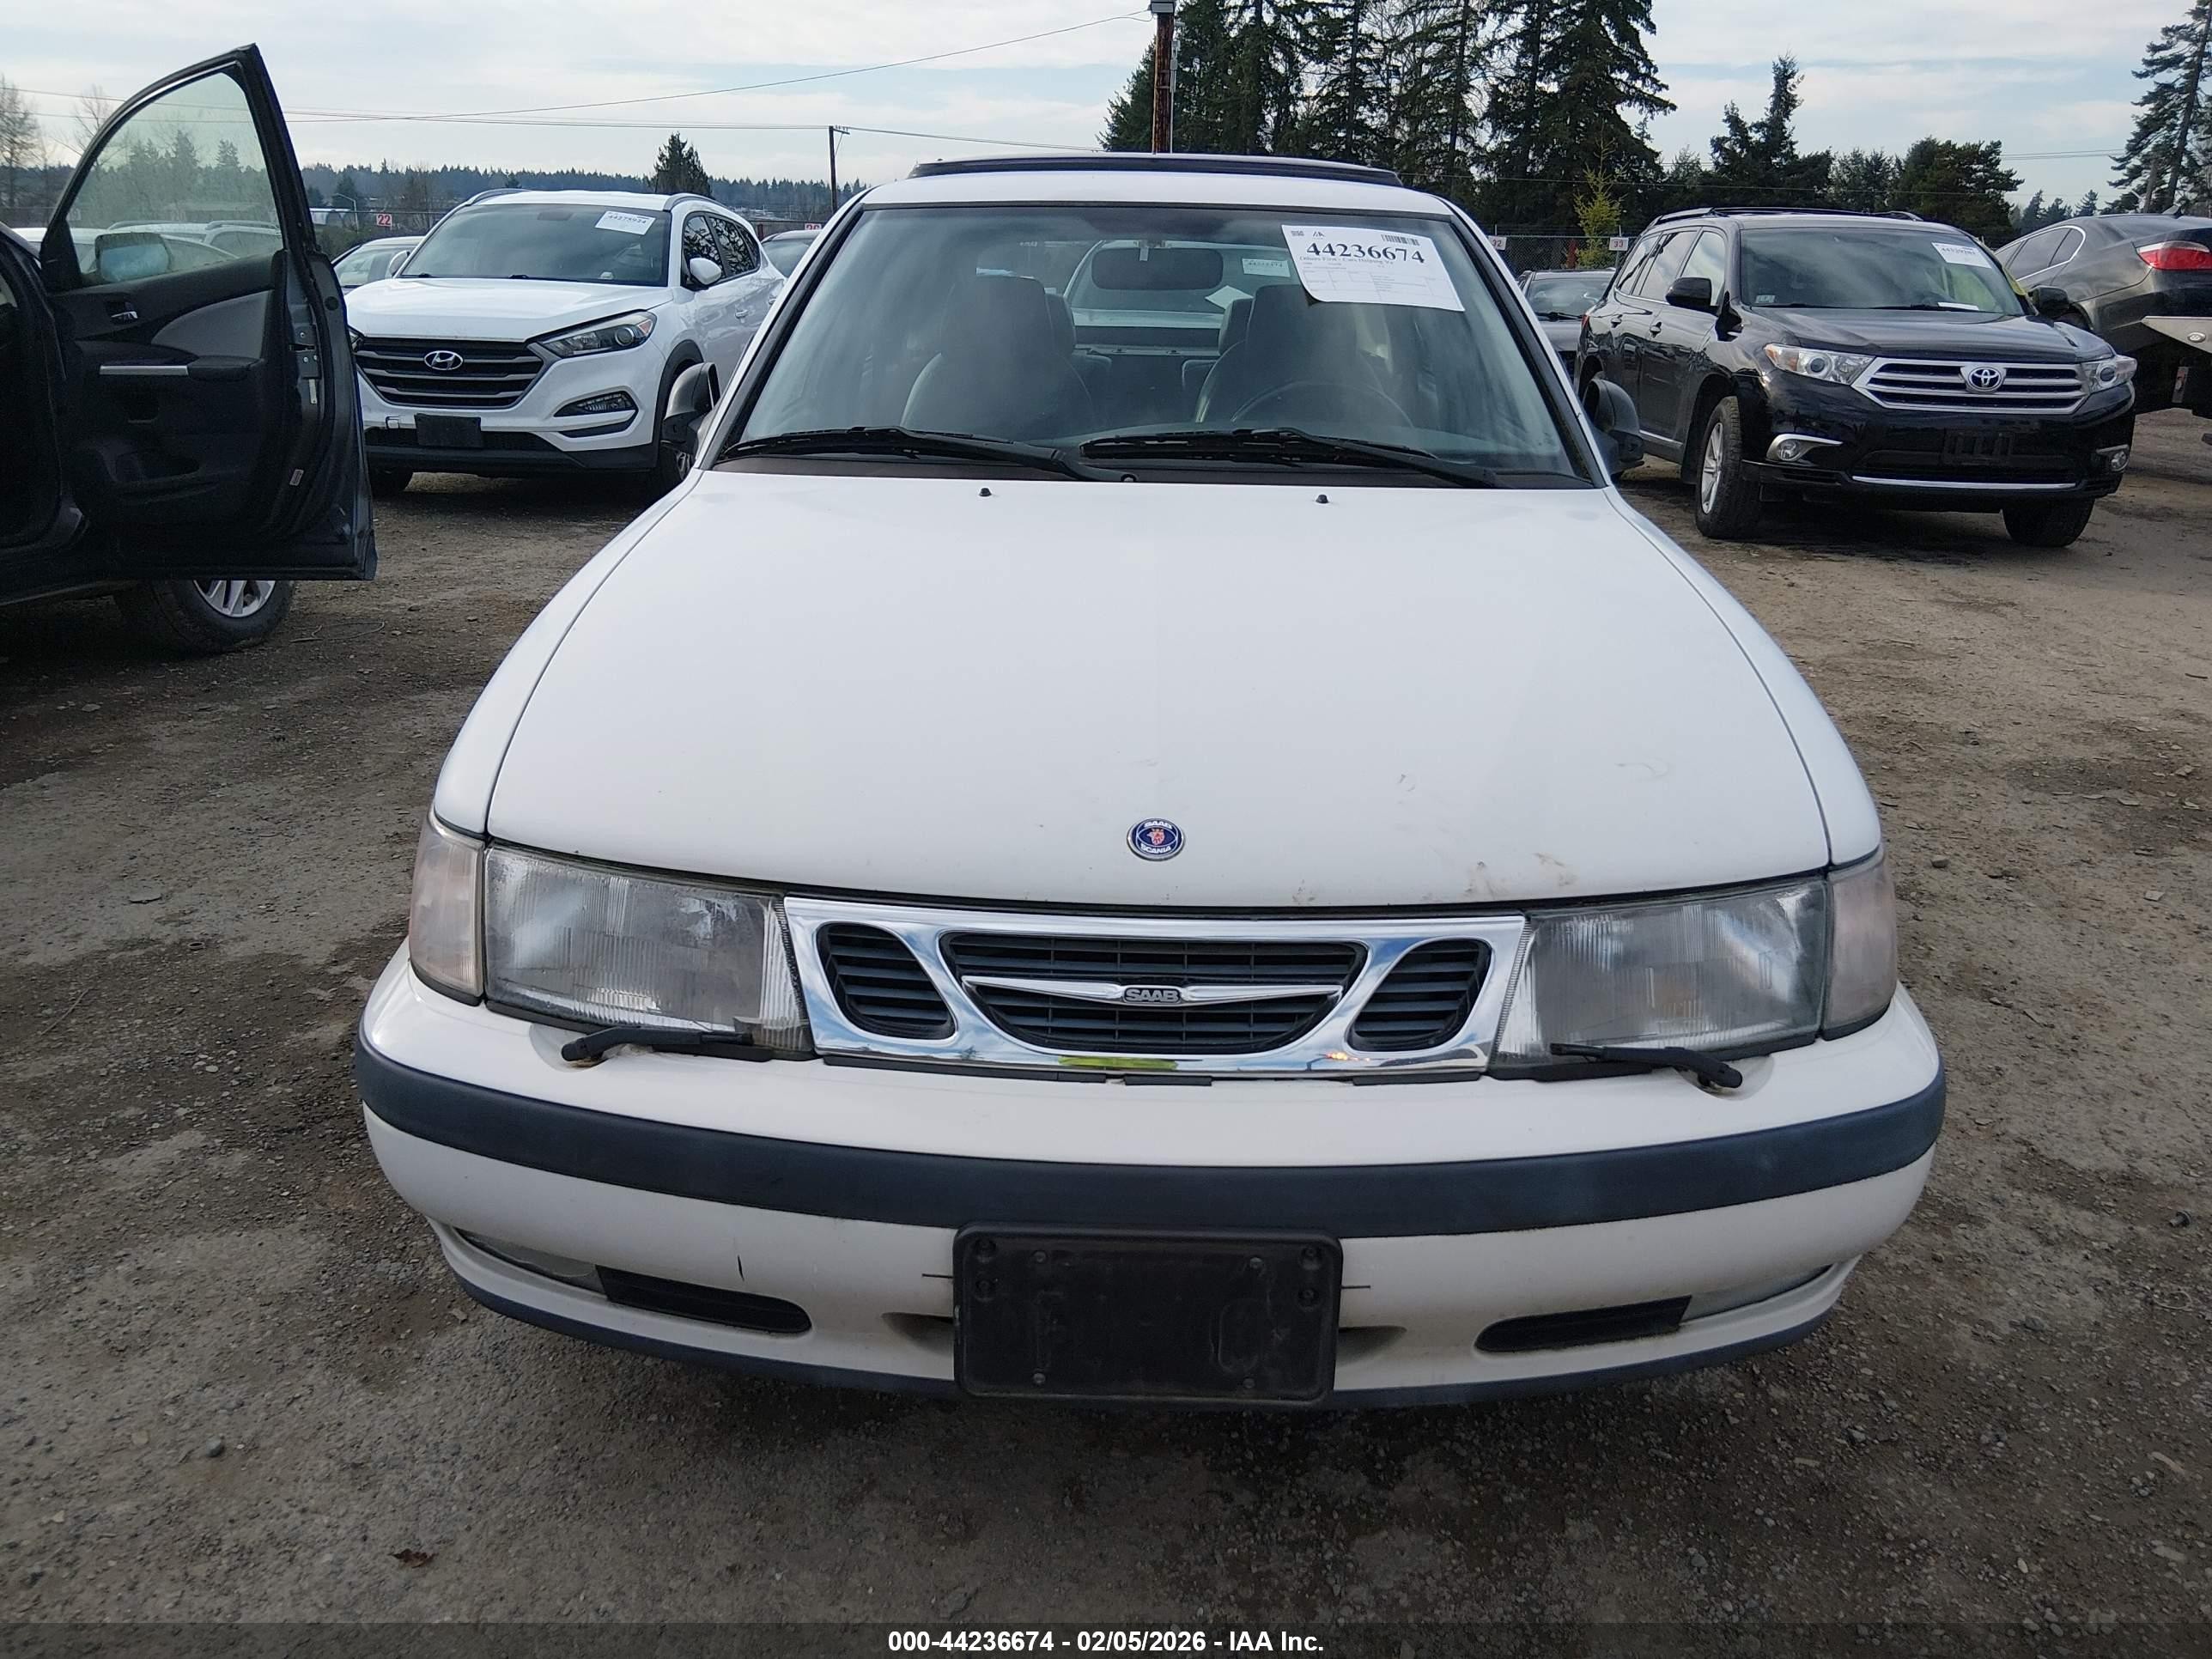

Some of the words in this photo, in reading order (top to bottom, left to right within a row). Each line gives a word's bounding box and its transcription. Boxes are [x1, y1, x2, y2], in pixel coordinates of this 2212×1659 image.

[378, 214, 392, 226] 22
[1306, 242, 1425, 264] 44236674
[1144, 820, 1173, 830] SAAB
[1140, 843, 1172, 854] SCANIA
[1125, 988, 1179, 1002] SAAB
